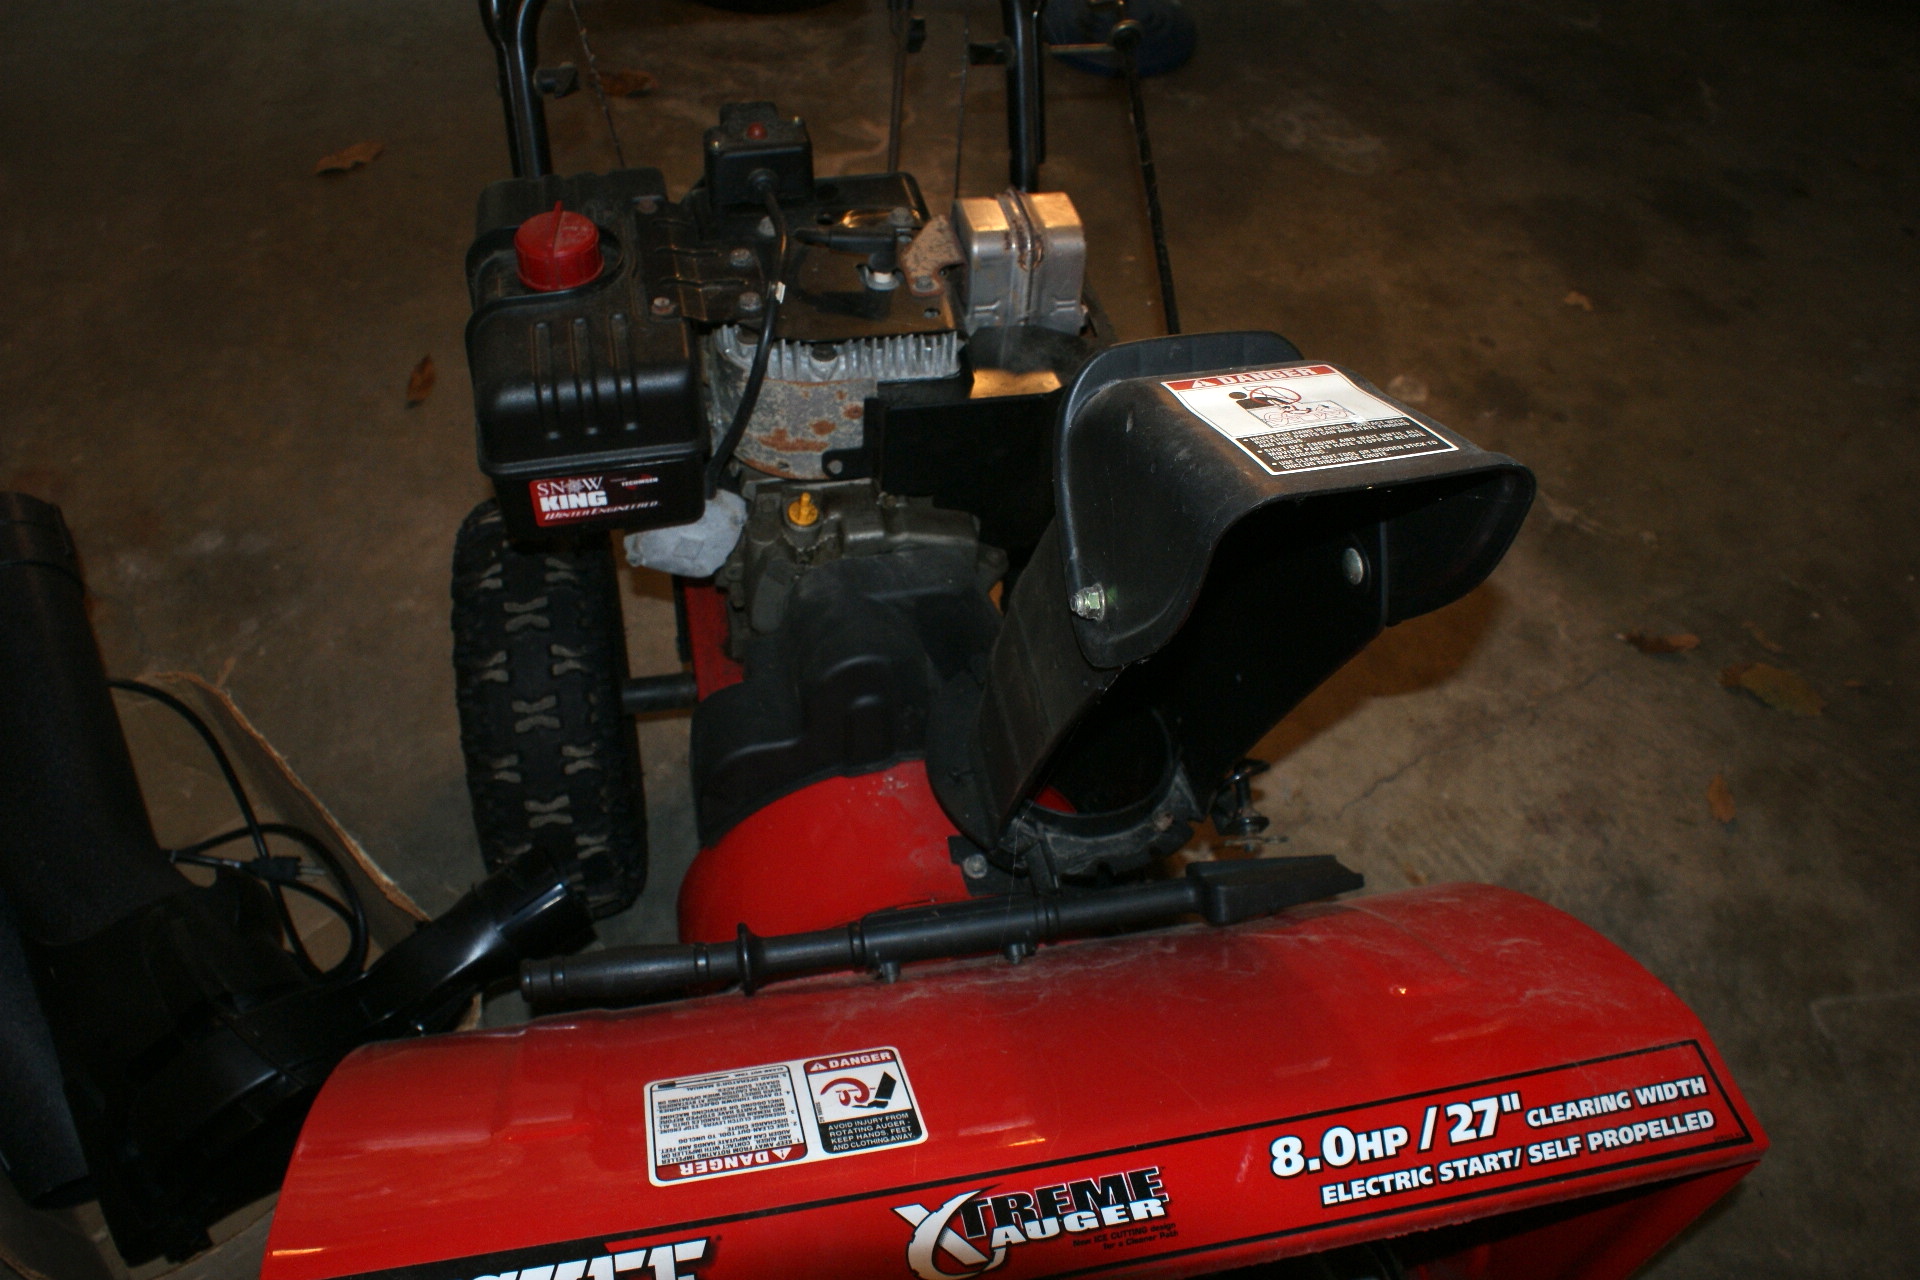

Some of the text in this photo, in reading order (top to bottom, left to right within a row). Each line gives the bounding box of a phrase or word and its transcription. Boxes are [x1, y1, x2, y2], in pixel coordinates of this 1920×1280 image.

[1217, 367, 1317, 385] DANGER
[539, 490, 608, 512] KING
[828, 1052, 891, 1068] DANGER
[828, 1113, 909, 1131] AVOID INJURY FROM
[830, 1126, 874, 1137] ROTATING
[875, 1120, 905, 1131] AUGER
[1271, 1127, 1408, 1177] 8.0HP
[1446, 1093, 1521, 1143] 27"
[1527, 1091, 1631, 1127] CLEARING
[1635, 1076, 1708, 1107] WIDTH
[718, 1135, 752, 1145] AMPUTATE
[769, 1129, 790, 1137] AUGER
[831, 1136, 854, 1144] KEEP
[890, 1127, 912, 1135] FEET
[694, 1141, 715, 1149] HANDS
[722, 1141, 750, 1149] CONTACT
[833, 1133, 915, 1152] AND CLOTHING AWAY.
[662, 1155, 695, 1165] IMPELLER
[672, 1148, 703, 1157] IMPELLER
[697, 1149, 730, 1159] ROTATING
[1322, 1110, 1715, 1205] ELECTRIC START/ SELF PROPELLED
[679, 1151, 769, 1176] DANGER
[891, 1166, 1169, 1280] XTREME
[991, 1198, 1166, 1249] AUGER
[1094, 1234, 1107, 1242] ICE
[1110, 1227, 1148, 1239] CUTTING
[1150, 1223, 1177, 1233] design
[1126, 1236, 1156, 1245] Cleaner
[1159, 1230, 1179, 1238] Path
